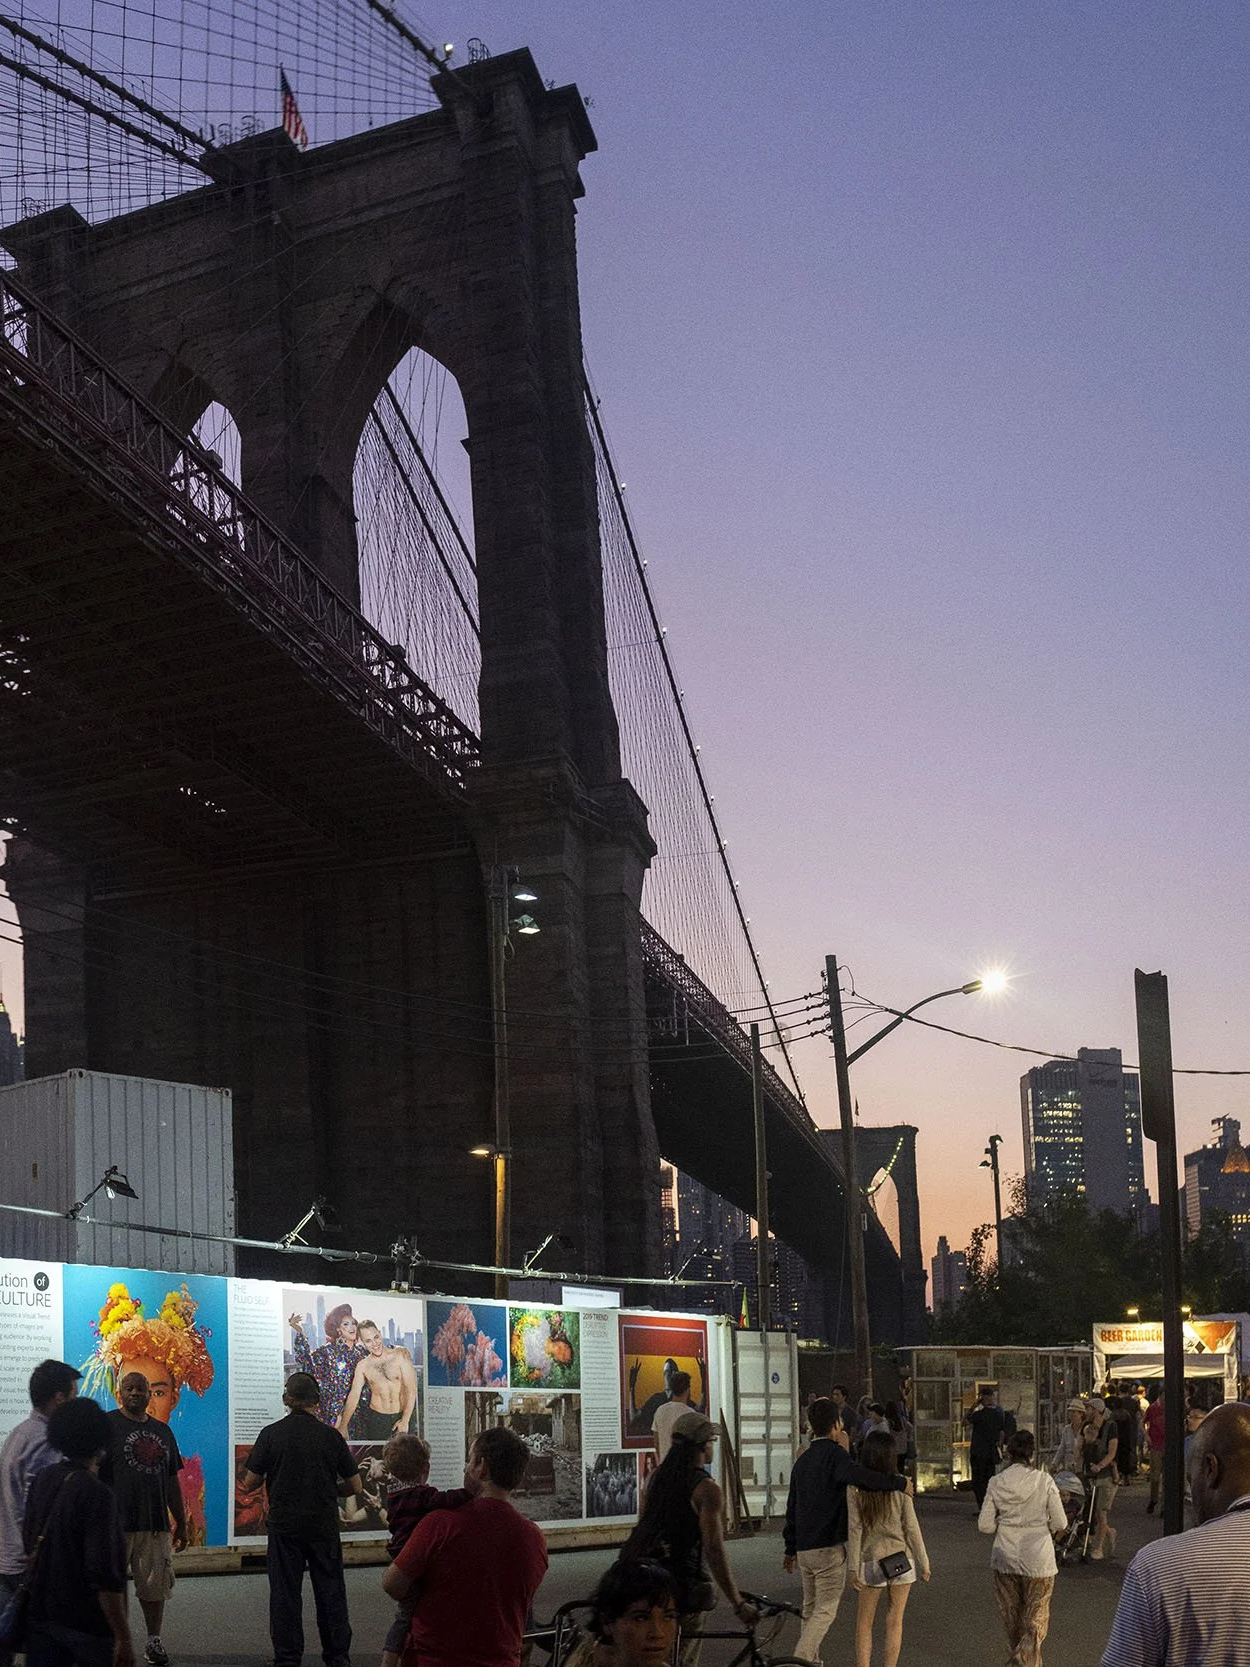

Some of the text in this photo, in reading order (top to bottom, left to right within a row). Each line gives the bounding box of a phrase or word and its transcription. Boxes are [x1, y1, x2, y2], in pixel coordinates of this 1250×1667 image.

[36, 1275, 46, 1287] of
[1101, 1330, 1162, 1342] BEER GARDEN
